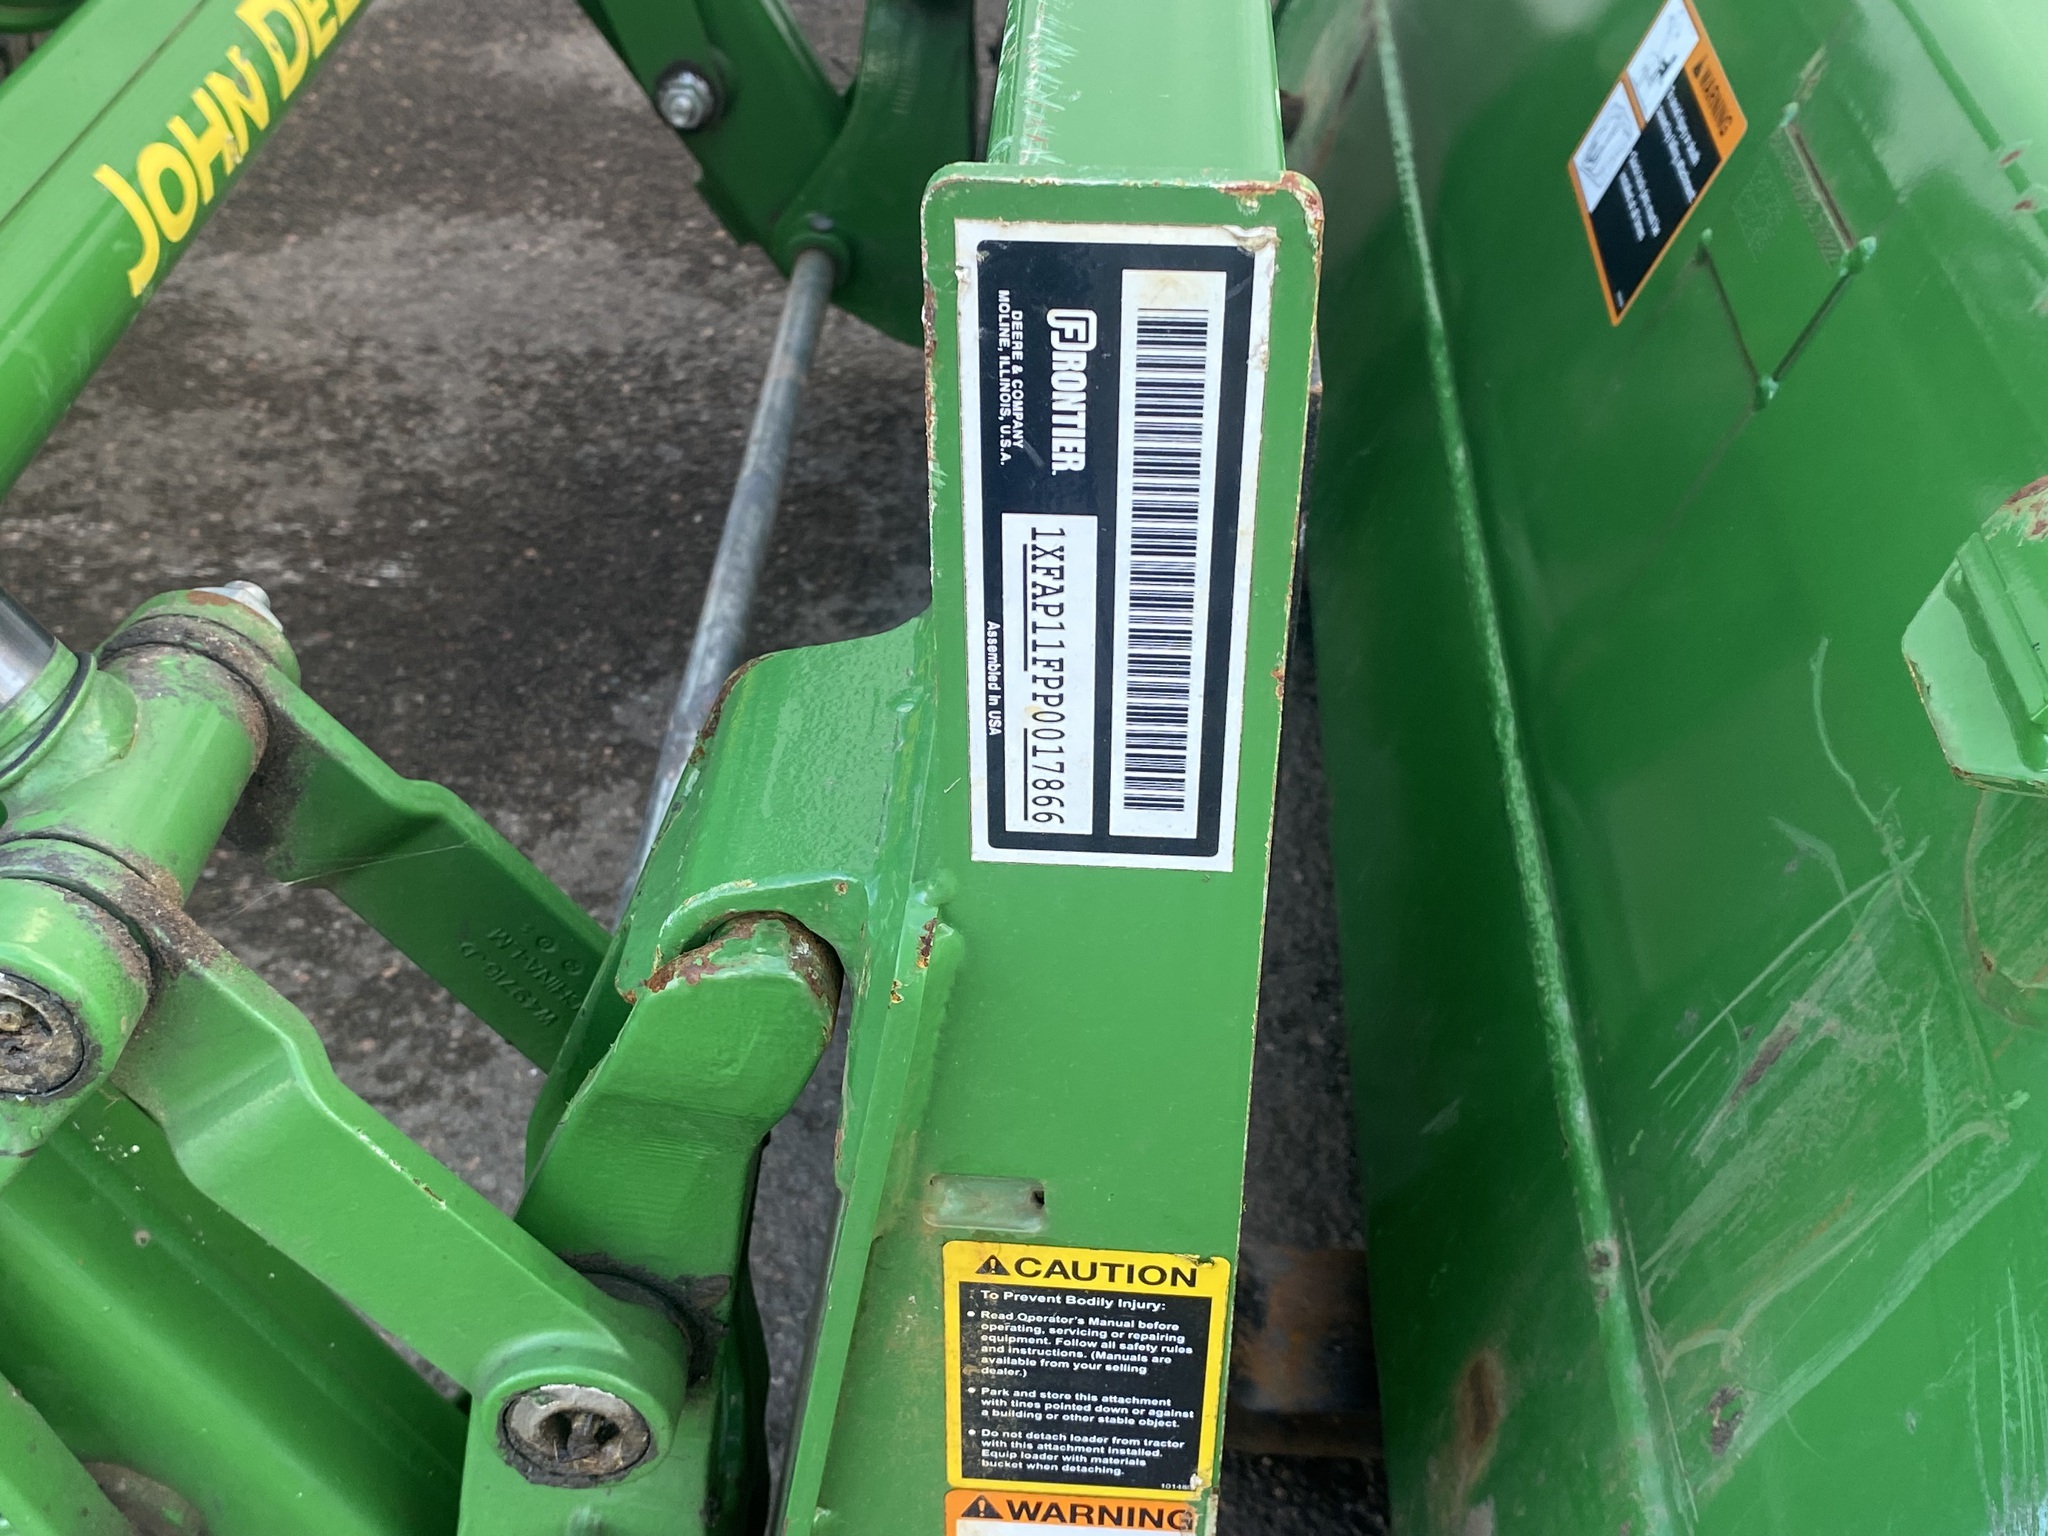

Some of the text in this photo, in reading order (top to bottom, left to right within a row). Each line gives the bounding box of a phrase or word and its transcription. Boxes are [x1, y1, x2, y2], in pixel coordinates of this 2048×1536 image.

[1697, 65, 1733, 139] WARNING
[93, 45, 270, 298] JOHN
[998, 290, 1011, 465] MOLINE, ILLINOIS, U.S.A.
[1012, 310, 1024, 448] DEERE & COMPANY
[1047, 309, 1098, 471] FRONTIER
[987, 620, 1000, 688] Assembled
[1031, 527, 1065, 824] 1XFAP11FPP0017866
[989, 709, 1002, 736] USA
[1014, 1257, 1197, 1287] CAUTION
[980, 1290, 1166, 1311] To Prevent Bodily Injury:
[981, 1311, 1179, 1331] Read Operator's Manual before
[981, 1323, 1045, 1335] operating,
[1049, 1327, 1107, 1338] servicing
[1128, 1332, 1185, 1344] repairing
[981, 1335, 1193, 1354] equipment. Follow all safety rules
[1008, 1346, 1087, 1358] instructions.
[1091, 1351, 1148, 1362] (Manuals
[1151, 1356, 1172, 1364] are
[981, 1357, 1147, 1375] available from your selling
[981, 1367, 1027, 1377] dealer.)
[981, 1387, 1171, 1406] Park and store this attachment
[992, 1409, 1042, 1420] building
[1062, 1414, 1094, 1422] other
[1098, 1416, 1135, 1425] stable
[1139, 1418, 1179, 1428] object.
[1011, 1400, 1040, 1408] tines
[1045, 1402, 1091, 1411] pointed
[1095, 1406, 1128, 1414] down
[1148, 1409, 1194, 1418] against
[981, 1429, 1185, 1448] Do not detach loader from tractor
[981, 1440, 1163, 1457] with this attachment installed.
[982, 1449, 1146, 1466] Equip loader with materials
[982, 1459, 1125, 1476] bucket when detaching.
[1006, 1500, 1192, 1530] WARNING
